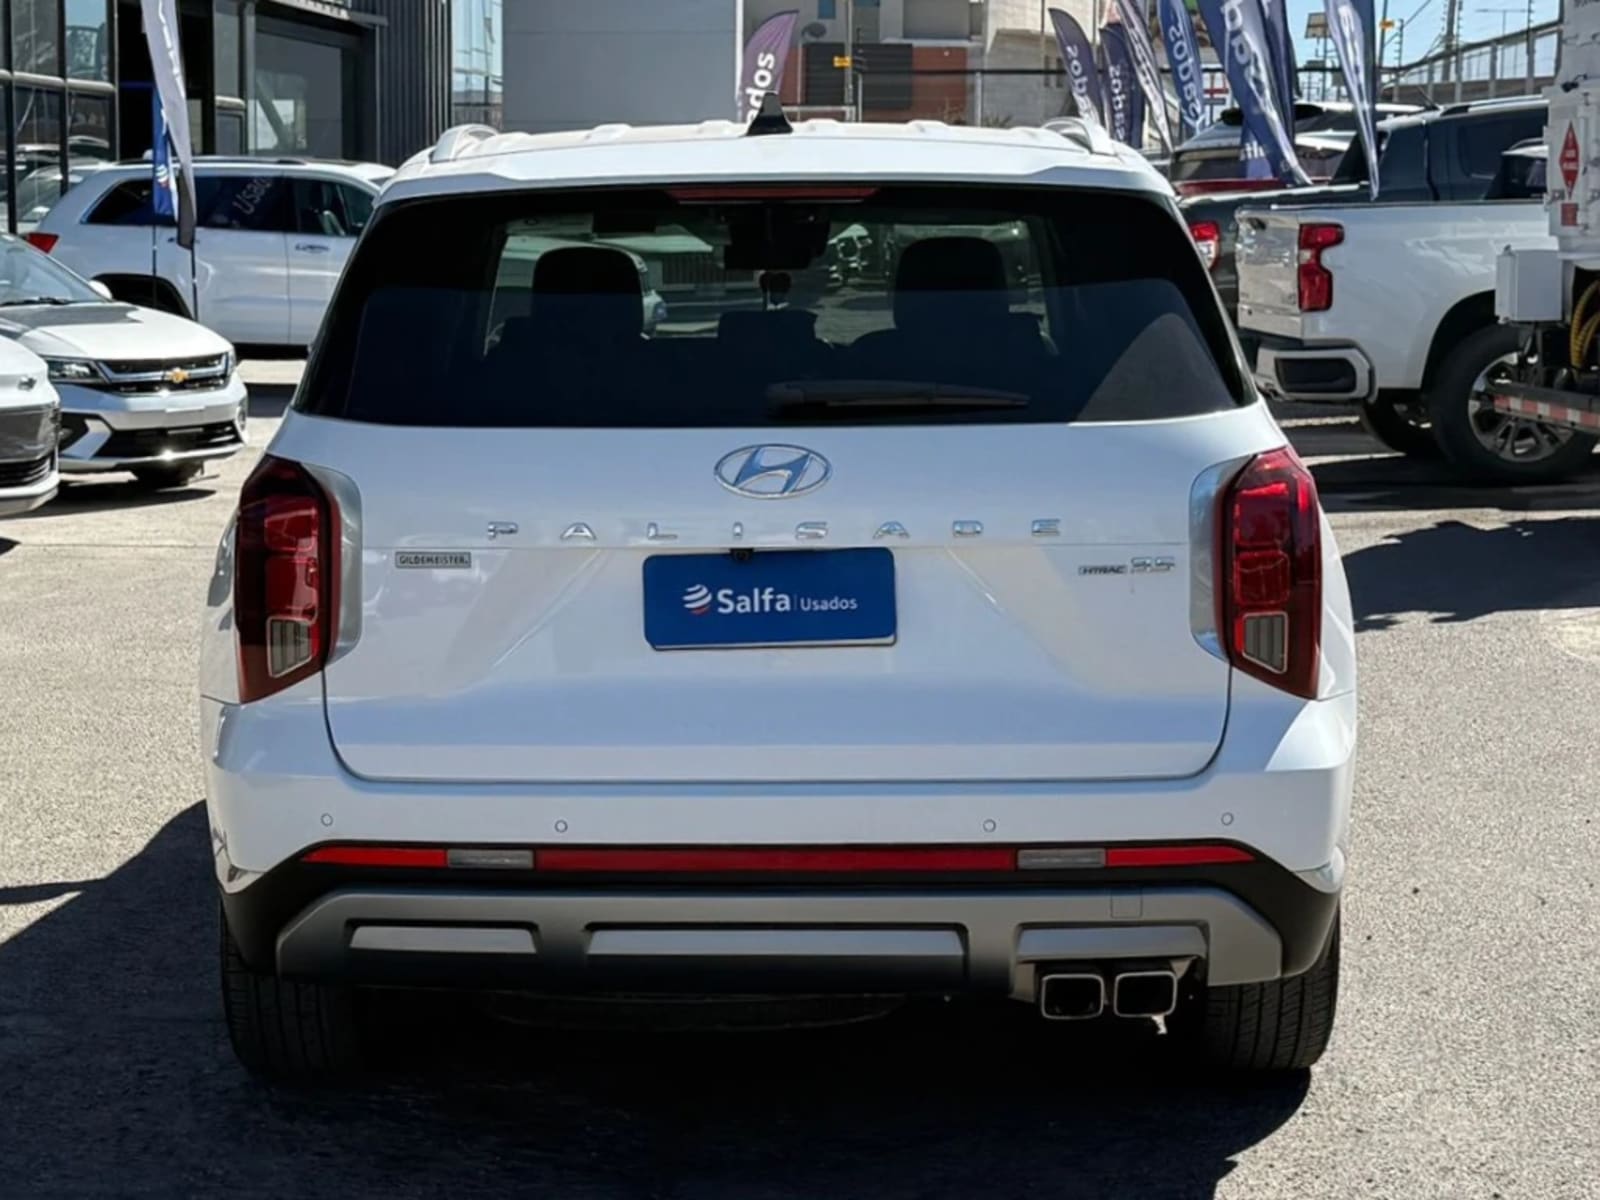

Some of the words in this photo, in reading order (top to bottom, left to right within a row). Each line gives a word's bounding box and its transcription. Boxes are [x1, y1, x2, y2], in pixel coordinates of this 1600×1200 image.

[486, 519, 1062, 541] PALISADE
[716, 587, 792, 614] Salfa
[800, 596, 858, 612] Usados
